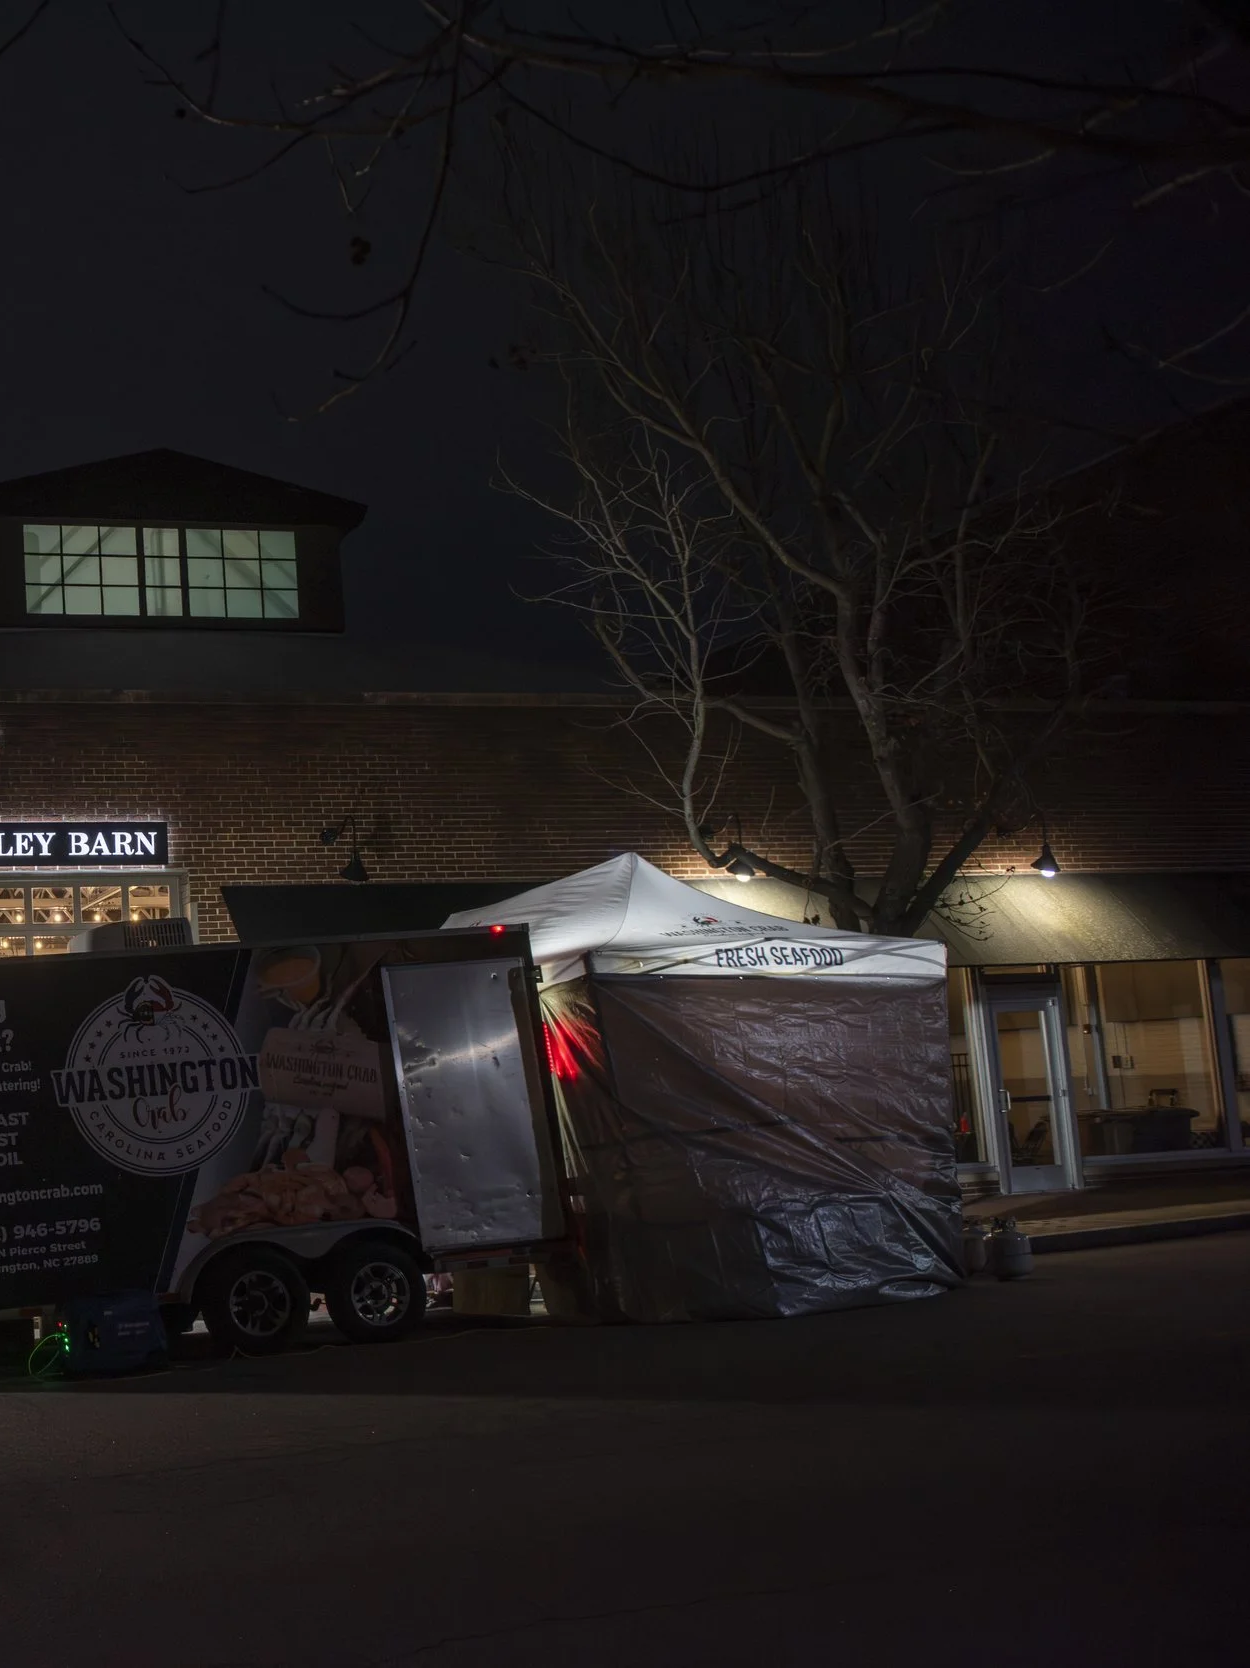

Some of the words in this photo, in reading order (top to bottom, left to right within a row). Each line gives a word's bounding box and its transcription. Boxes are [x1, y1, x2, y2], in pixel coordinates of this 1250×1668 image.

[68, 831, 158, 857] BARN
[715, 947, 770, 967] FRESH
[770, 946, 844, 966] SEAFOOD
[120, 1048, 157, 1059] SINCE
[1, 1060, 32, 1073] Crab!
[53, 1055, 260, 1105] WASHINGTON
[133, 1084, 188, 1129] Crab
[90, 1111, 165, 1161] CAROLINA
[176, 1100, 232, 1159] SEAFOOD
[13, 1217, 102, 1240] 946-5796
[10, 1245, 47, 1258] Pierce
[49, 1240, 87, 1254] Street
[43, 1257, 61, 1269] NC
